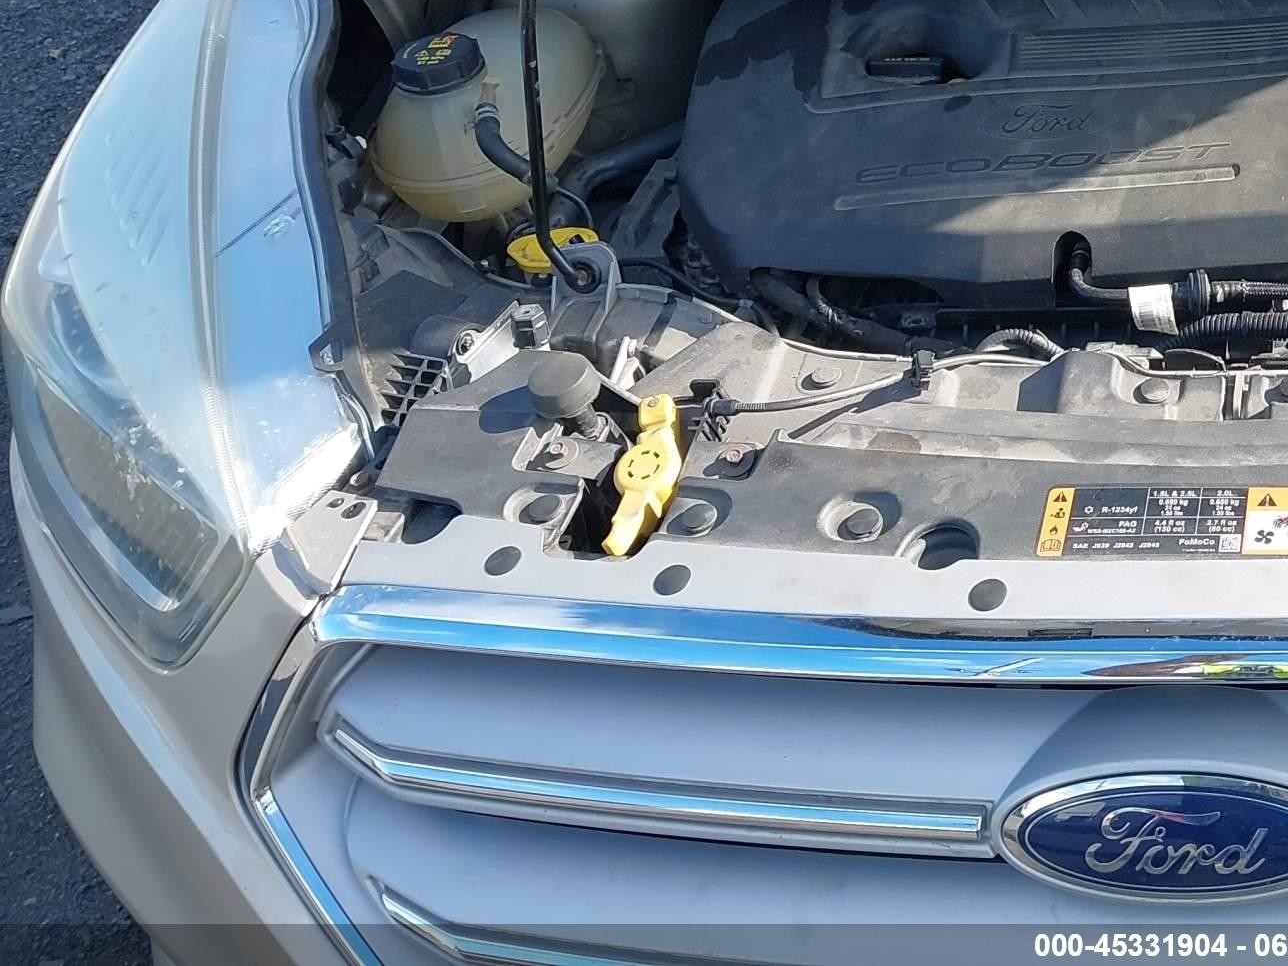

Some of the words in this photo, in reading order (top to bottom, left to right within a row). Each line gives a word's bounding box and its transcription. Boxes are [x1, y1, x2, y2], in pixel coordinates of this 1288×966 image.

[1002, 104, 1096, 133] Ford
[855, 141, 1231, 184] ECOBOOST
[1179, 498, 1189, 507] kg
[1230, 498, 1240, 507] kg
[1101, 505, 1138, 514] R-1234yf
[1178, 538, 1216, 546] FoMoCo
[1084, 807, 1269, 875] Ford
